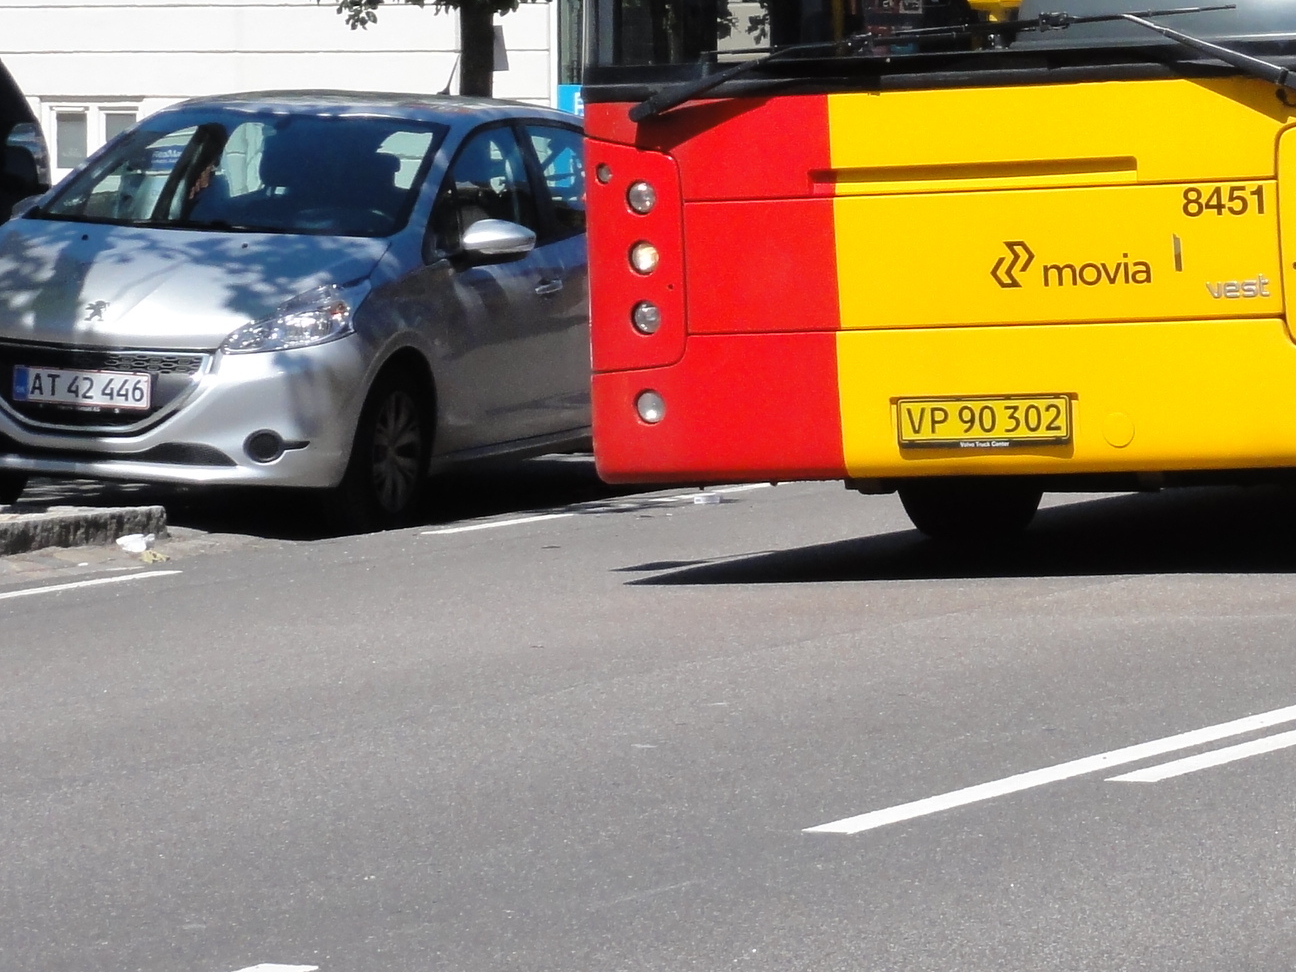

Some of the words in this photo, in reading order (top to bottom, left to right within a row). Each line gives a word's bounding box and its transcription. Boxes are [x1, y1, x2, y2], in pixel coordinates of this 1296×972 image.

[1182, 185, 1265, 217] 8451
[1042, 252, 1152, 287] movia
[1206, 274, 1271, 299] vest
[30, 373, 60, 396] AT
[67, 375, 94, 399] 42
[101, 378, 144, 402] 446
[906, 406, 949, 434] VP
[958, 405, 996, 434] 90
[1004, 403, 1062, 433] 302
